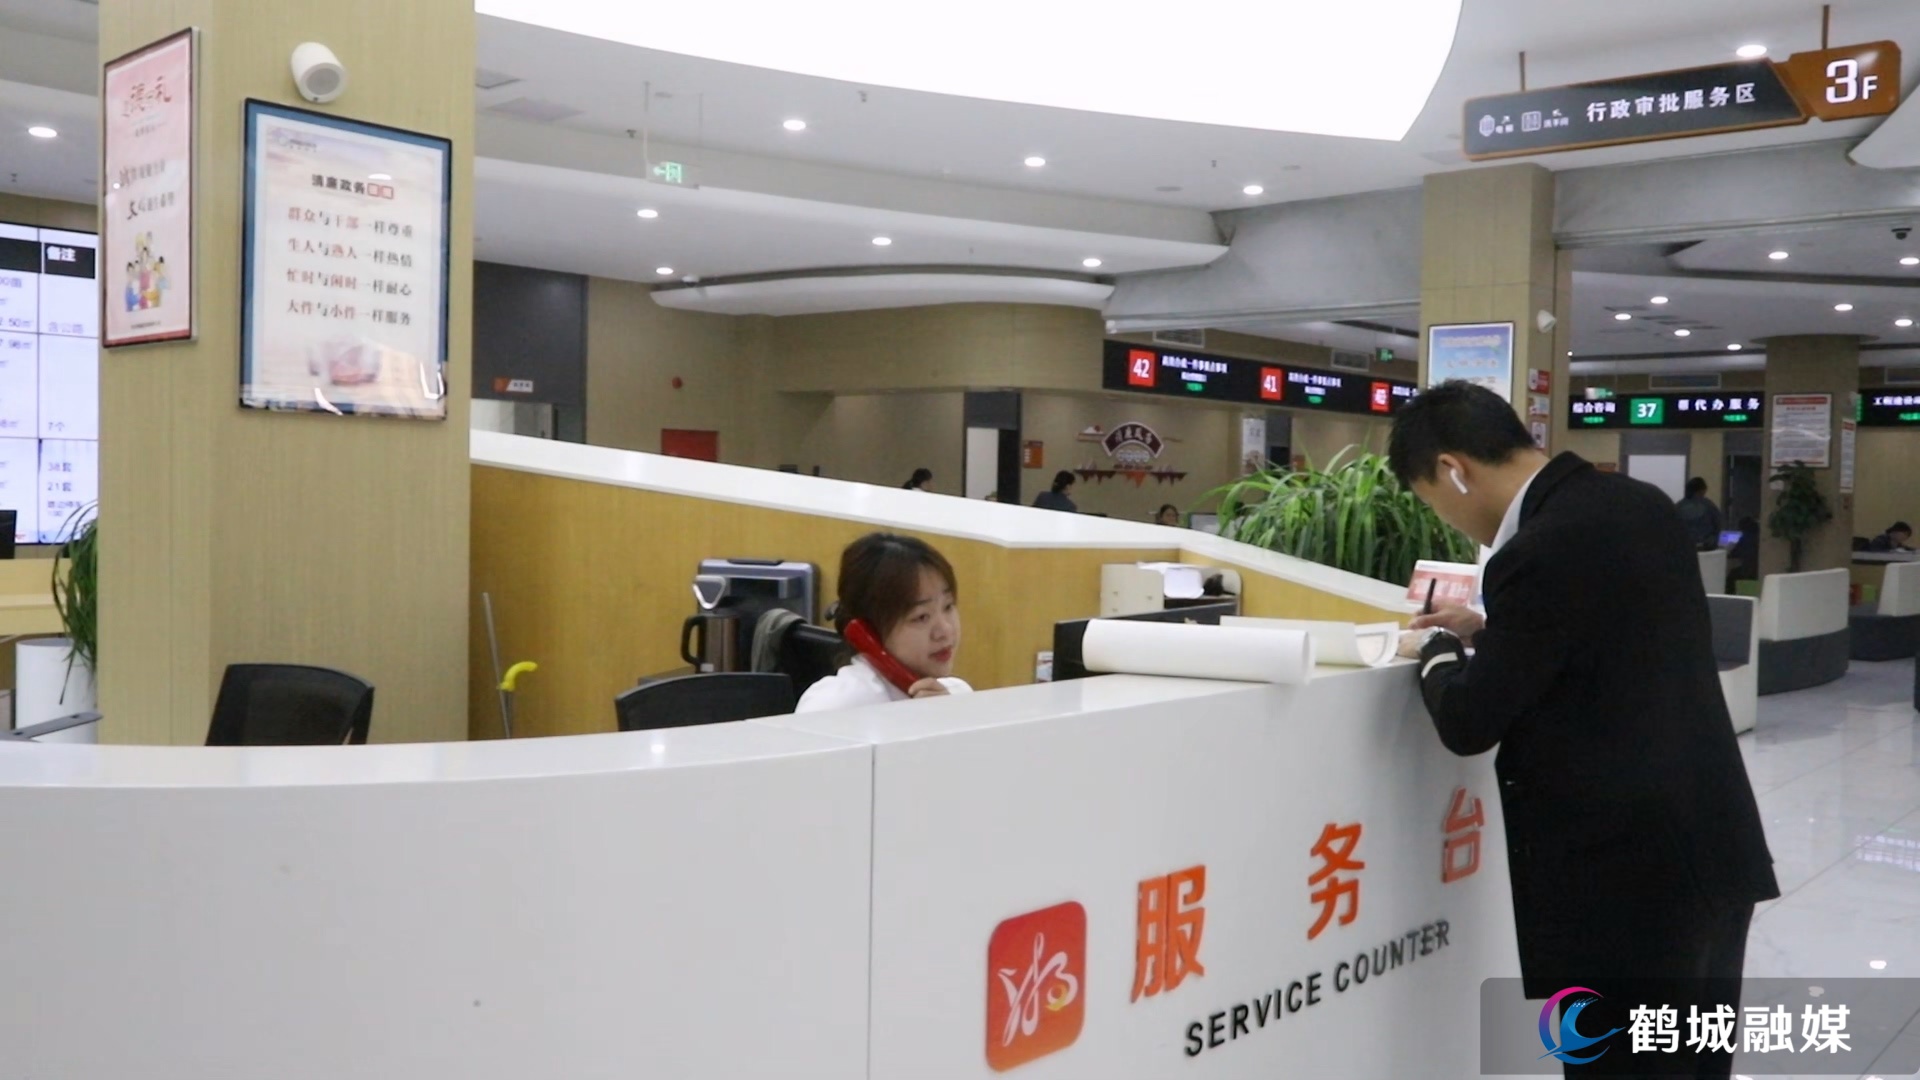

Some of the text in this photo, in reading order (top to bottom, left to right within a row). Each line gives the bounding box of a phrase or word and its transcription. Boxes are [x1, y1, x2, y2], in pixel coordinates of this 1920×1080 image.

[1825, 58, 1878, 105] 3F
[1586, 82, 1757, 123] 行政审批服务区
[288, 207, 413, 239] 群众与干部一样尊重
[46, 245, 77, 262] 备注
[288, 238, 412, 268] 生人与熟人一样热情
[287, 267, 412, 297] 忙时与闲时一样耐心
[287, 298, 411, 326] 大件与小件一样服务
[1133, 358, 1150, 379] 42
[1263, 374, 1278, 393] 41
[1637, 403, 1657, 418] 37
[1130, 786, 1485, 1004] 服务台
[1184, 919, 1452, 1058] SERVICE COUNTER
